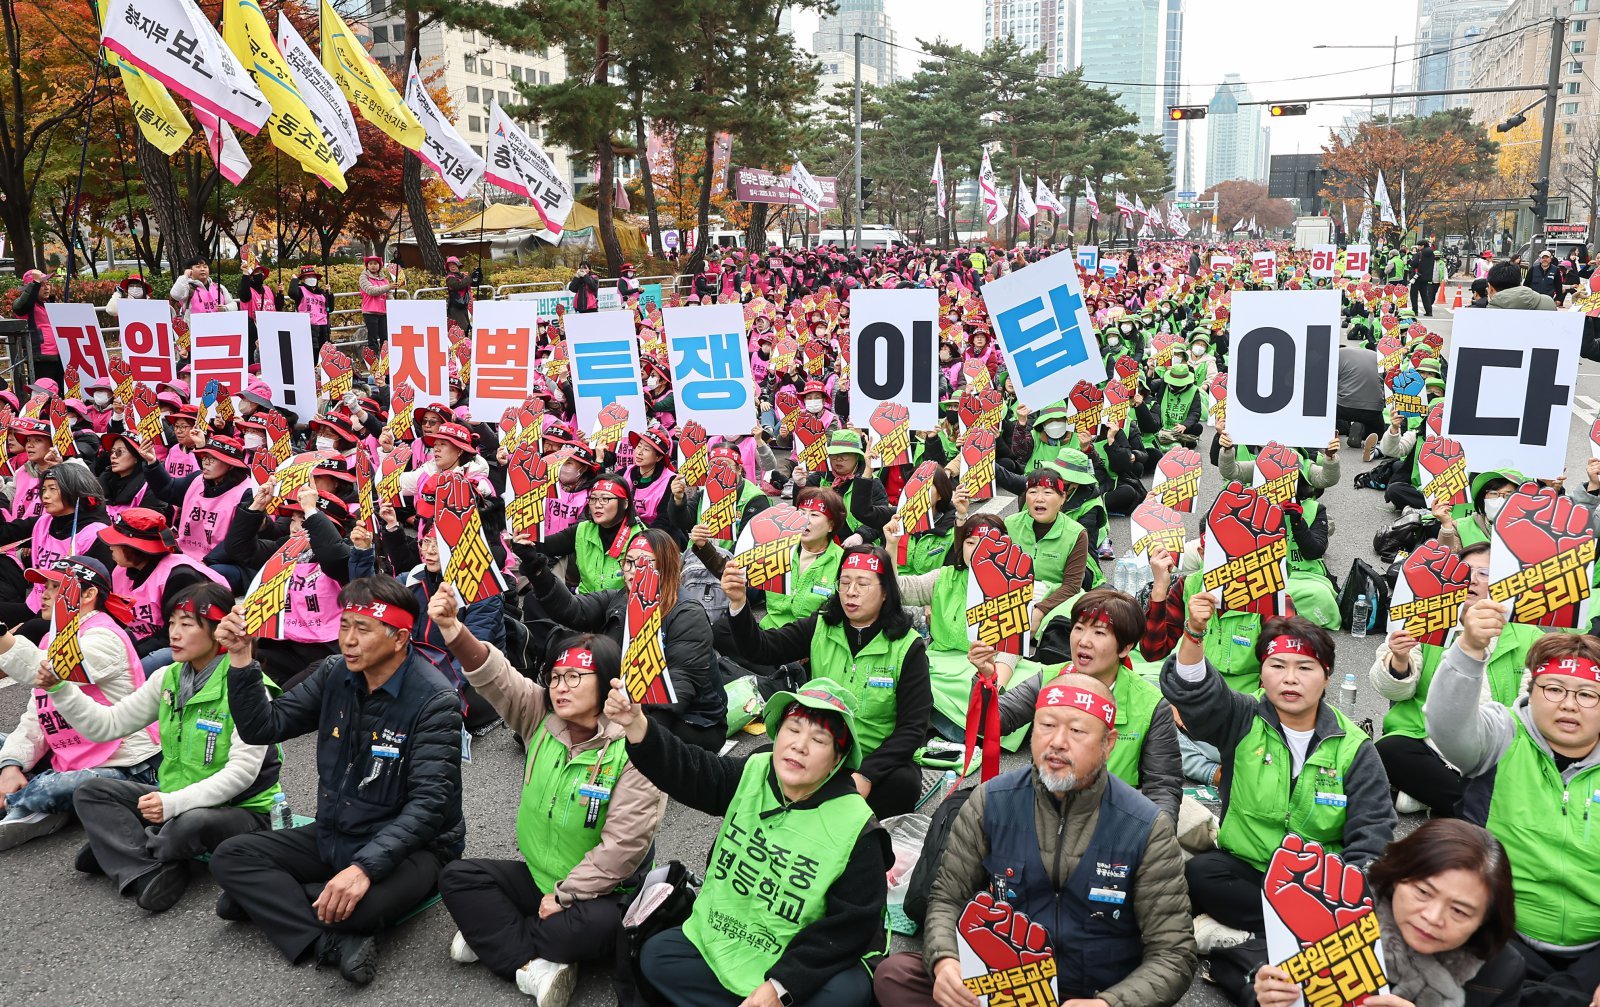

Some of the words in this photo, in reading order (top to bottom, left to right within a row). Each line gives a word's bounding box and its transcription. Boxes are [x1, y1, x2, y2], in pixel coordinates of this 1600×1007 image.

[131, 100, 178, 138] 서울지부
[1313, 251, 1334, 270] 하
[1346, 252, 1368, 271] 라
[56, 325, 108, 379] 저
[124, 321, 172, 382] 임
[996, 284, 1089, 388] 답
[194, 334, 244, 399] 금
[391, 325, 447, 397] 차
[475, 327, 530, 400] 별
[573, 340, 638, 408] 투
[672, 332, 748, 411] 쟁
[857, 320, 932, 404] 이
[1235, 324, 1332, 418] 이
[330, 378, 353, 400] 승리!
[1448, 346, 1570, 446] 다
[1076, 411, 1101, 432] 승리!
[806, 445, 829, 470] 승리!
[882, 430, 910, 466] 승리!
[280, 469, 310, 496] 승리!
[685, 455, 708, 486] 승리!
[965, 464, 995, 497] 승리!
[1434, 472, 1467, 504] 승리!
[903, 493, 931, 533] 승리!
[1161, 482, 1199, 508] 승리!
[512, 500, 545, 532] 승리!
[707, 506, 736, 536] 승리!
[456, 535, 492, 602] 승리!
[747, 549, 792, 587] 승리!
[847, 556, 880, 570] 파업
[1203, 536, 1287, 589] 집단임금교섭
[1488, 539, 1597, 603] 집단임금교섭
[966, 583, 1034, 626] 집단임금교섭
[1223, 565, 1285, 610] 승리!
[1389, 588, 1469, 620] 집단임금교섭
[1513, 568, 1591, 623] 승리!
[246, 581, 286, 636] 승리!
[978, 605, 1031, 646] 승리!
[1403, 605, 1458, 638] 승리!
[52, 632, 84, 680] 승리!
[556, 650, 593, 667] 파업
[625, 637, 667, 702] 승리!
[1046, 688, 1116, 725] 총파업
[963, 956, 1056, 997] 집단임금교섭
[1303, 946, 1387, 1007] 승리!
